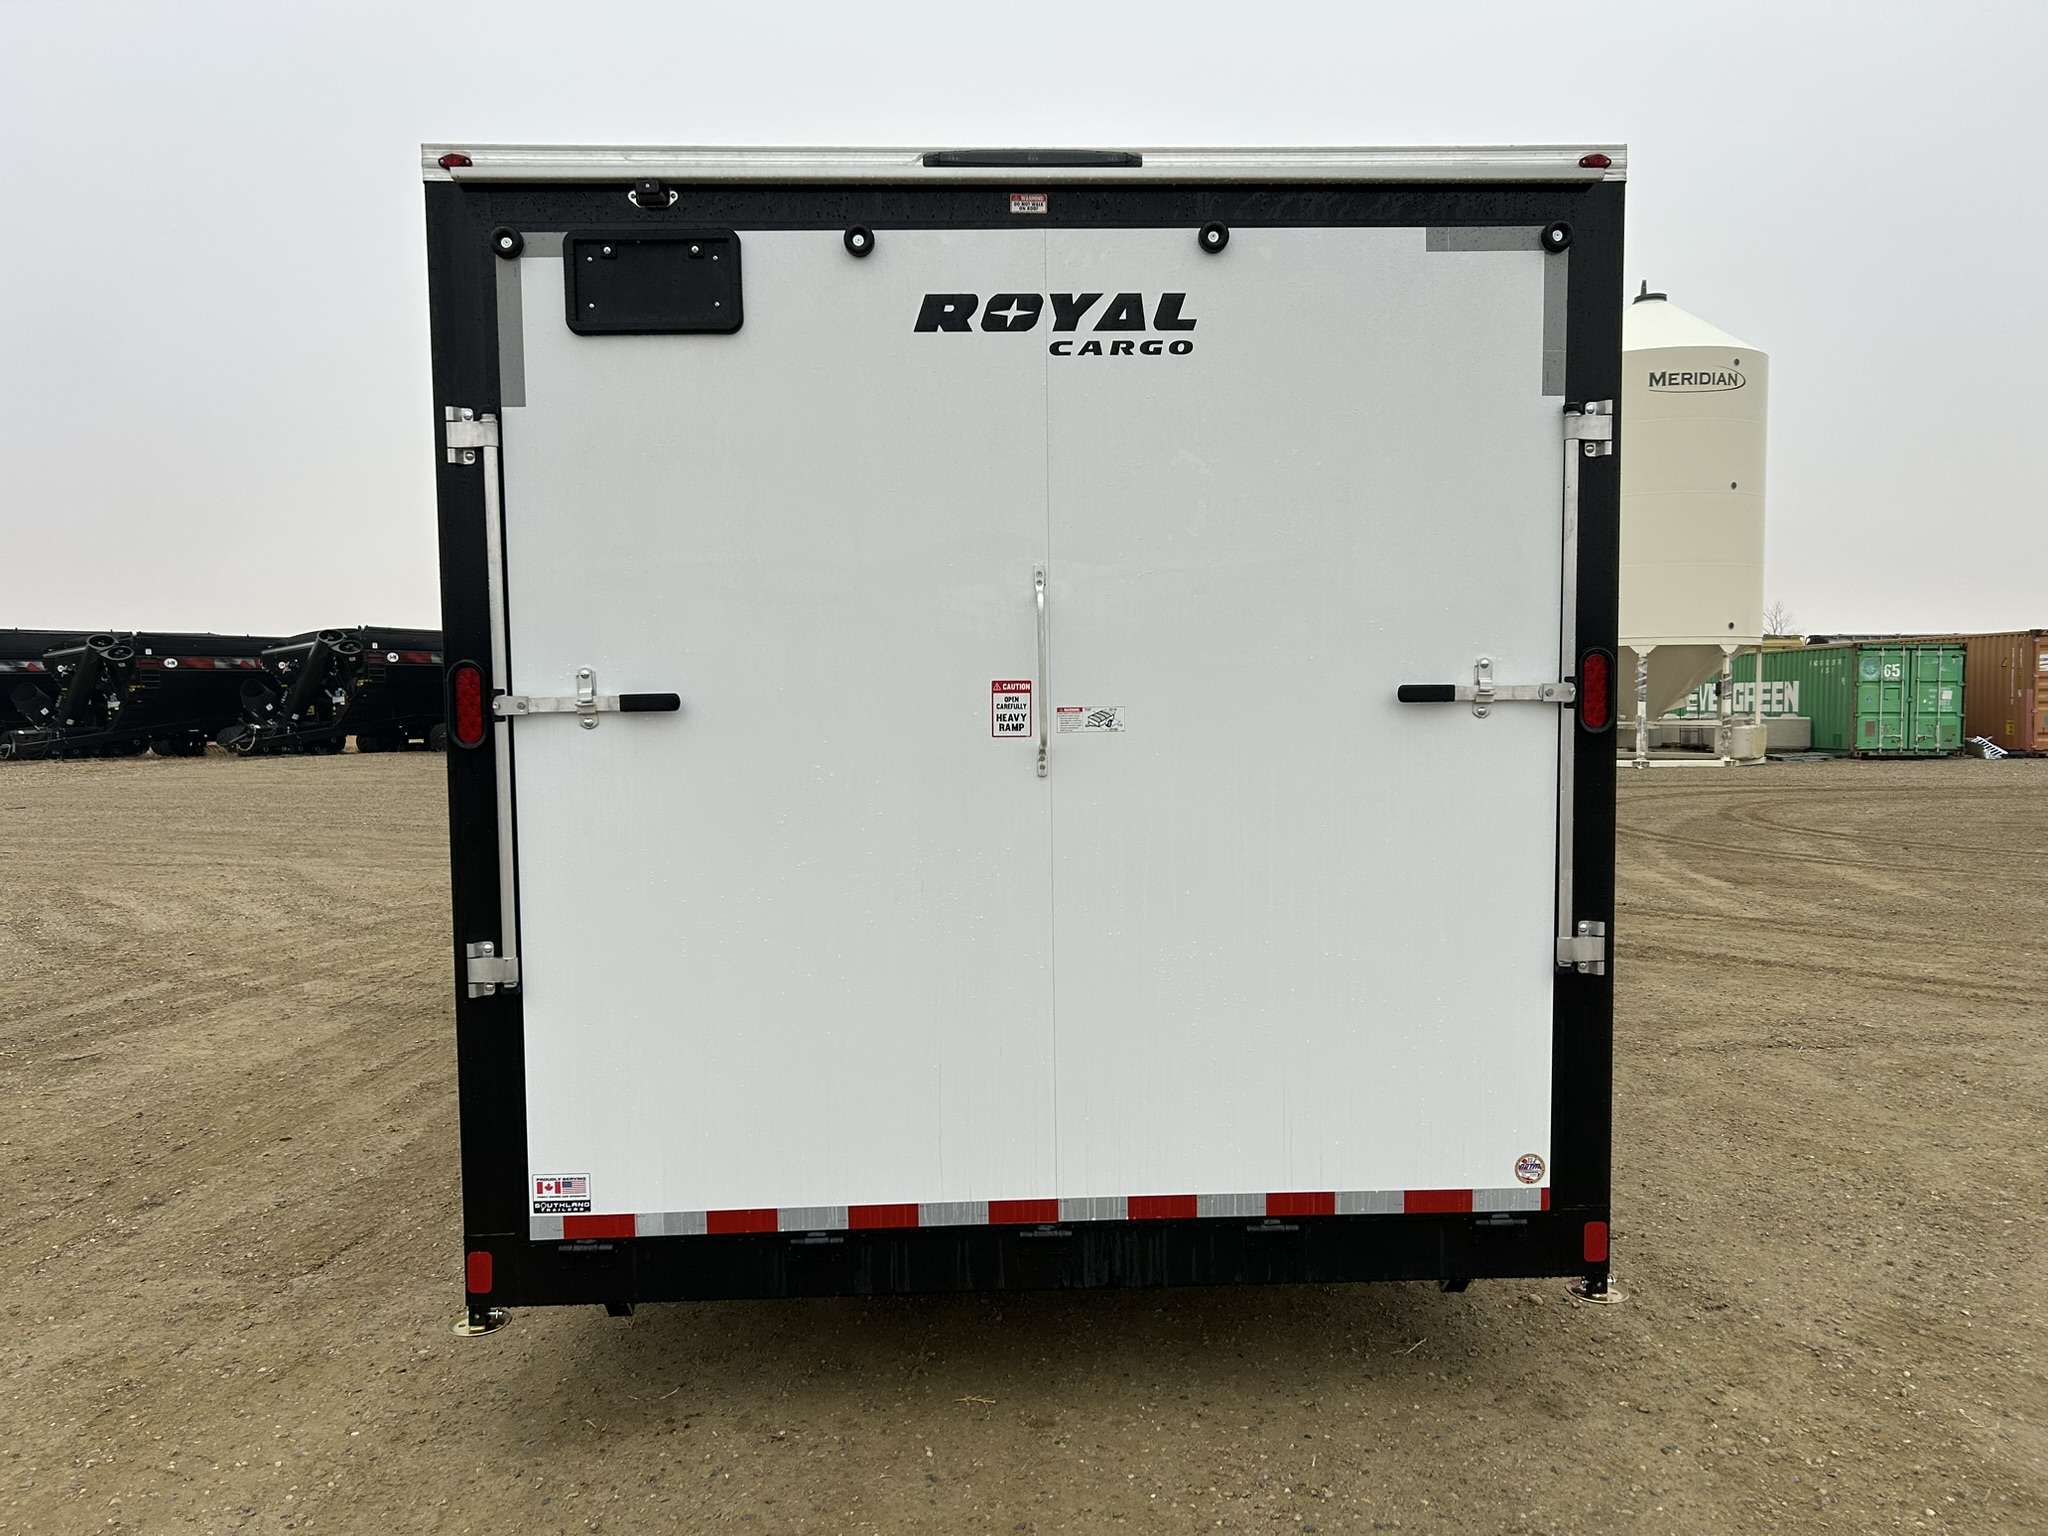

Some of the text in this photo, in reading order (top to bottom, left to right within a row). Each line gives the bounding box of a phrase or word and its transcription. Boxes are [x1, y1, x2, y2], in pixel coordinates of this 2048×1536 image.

[913, 293, 1197, 332] ROYAL
[1048, 340, 1194, 356] CARGO
[1648, 371, 1738, 387] MERIDIAN
[1884, 663, 1900, 677] 65
[1002, 683, 1031, 691] CAUTION
[996, 713, 1027, 722] HEAVY
[999, 723, 1025, 732] RAMP
